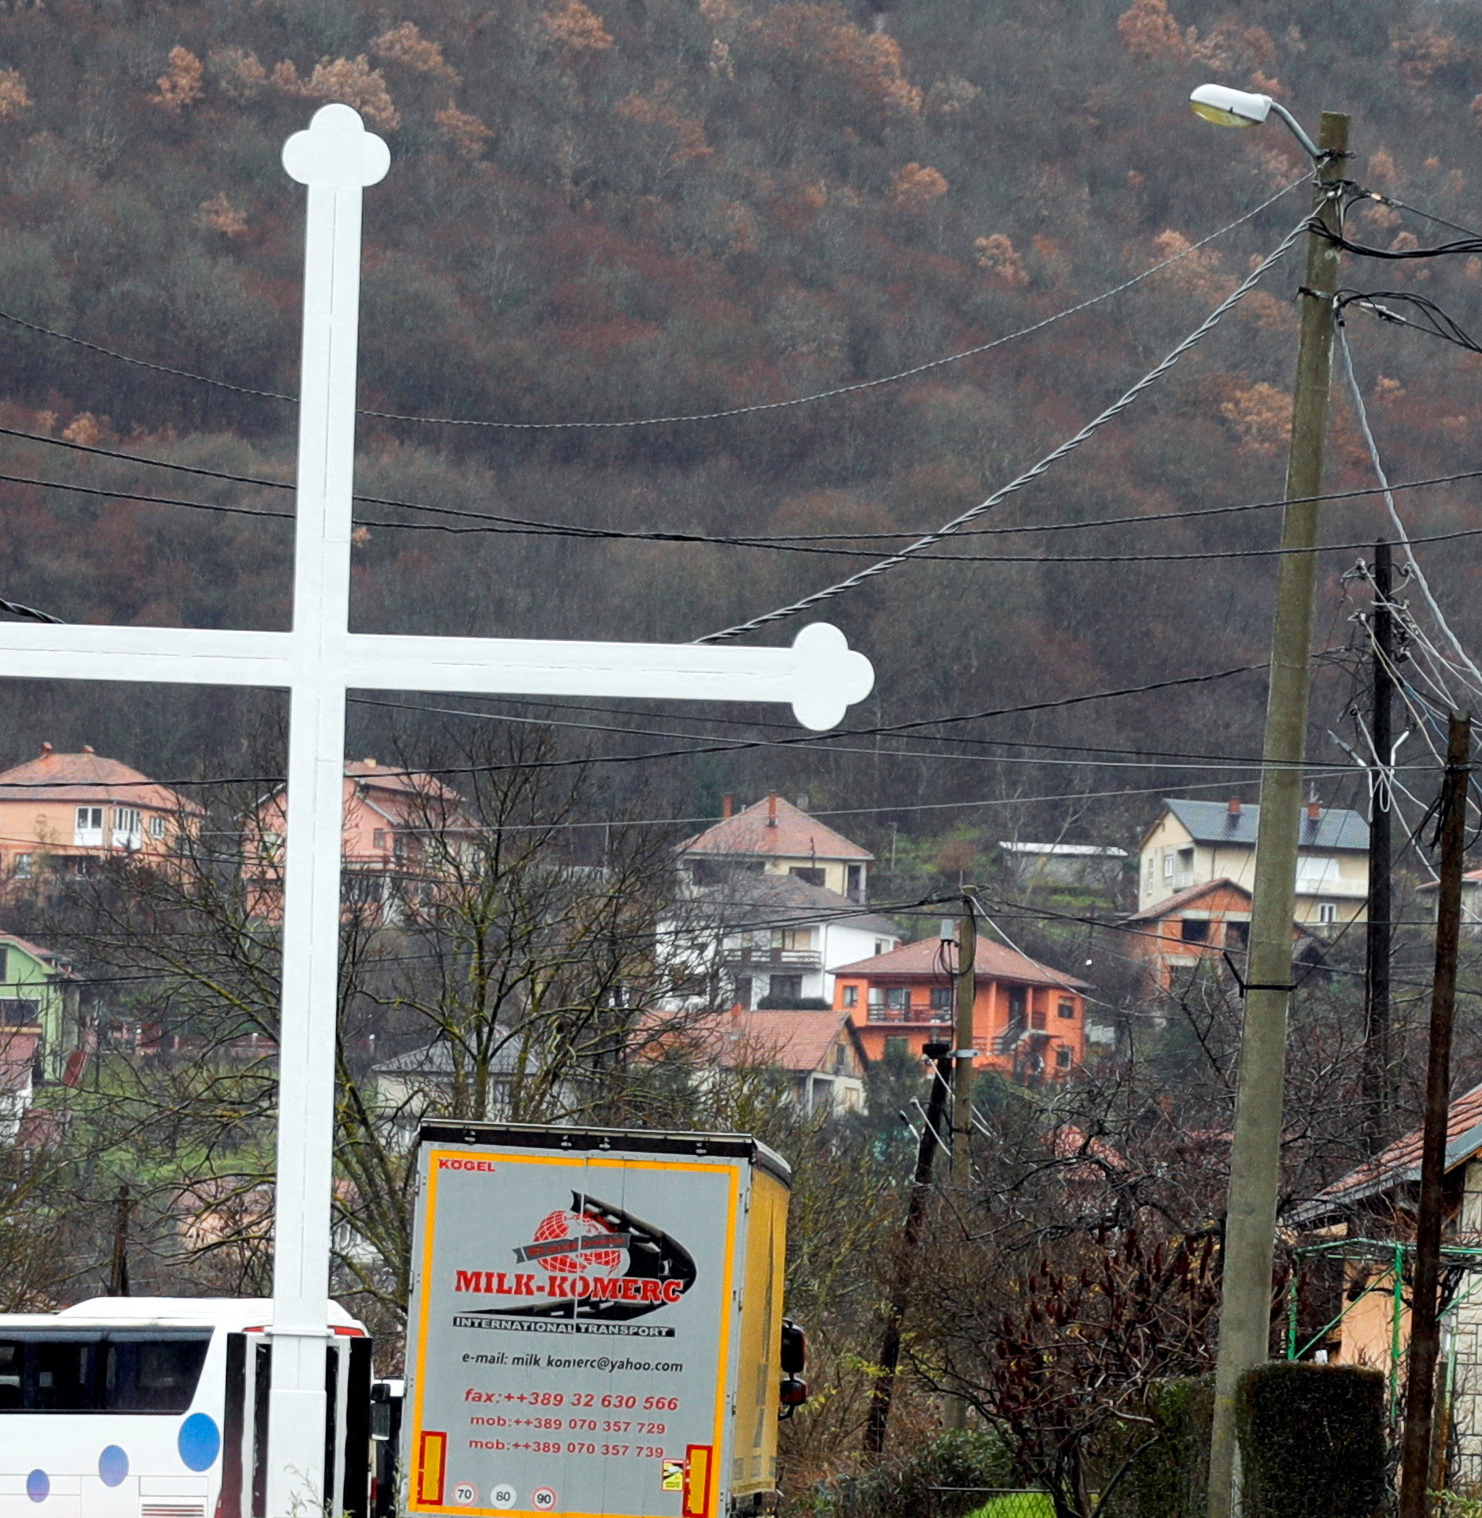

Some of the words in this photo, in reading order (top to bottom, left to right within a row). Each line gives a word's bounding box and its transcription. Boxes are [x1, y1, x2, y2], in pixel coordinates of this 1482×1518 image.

[455, 1270, 683, 1303] MILK-KOMERC
[456, 1317, 575, 1334] INTERNATIONAL
[579, 1323, 669, 1336] TRANSPORT
[462, 1352, 508, 1365] e-mail:
[570, 1393, 595, 1407] 32
[601, 1394, 636, 1409] 630
[642, 1396, 679, 1411] 566
[568, 1418, 597, 1431] 070
[602, 1420, 631, 1432] 357
[637, 1422, 666, 1434] 729
[567, 1442, 595, 1454] 070
[601, 1444, 629, 1456] 357
[636, 1446, 664, 1458] 739
[458, 1489, 472, 1499] 70
[496, 1491, 511, 1502] 80
[537, 1493, 551, 1504] 90
